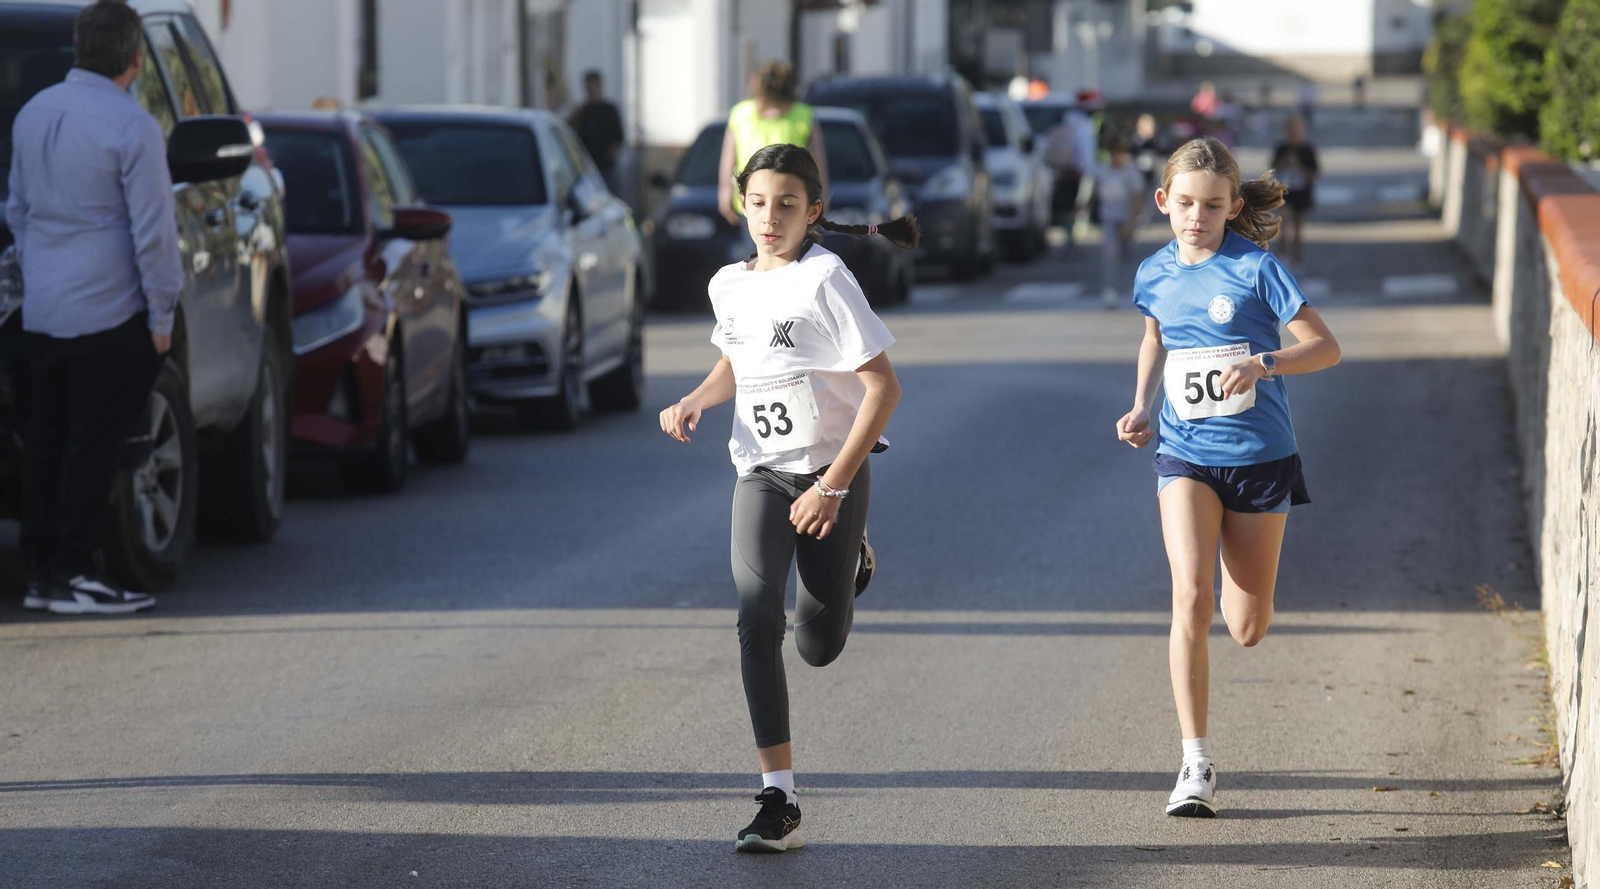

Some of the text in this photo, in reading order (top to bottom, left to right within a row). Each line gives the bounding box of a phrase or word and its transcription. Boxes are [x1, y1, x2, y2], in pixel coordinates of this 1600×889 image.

[771, 380, 805, 390] FRONTERA
[1184, 369, 1224, 405] 50
[753, 402, 793, 438] 53
